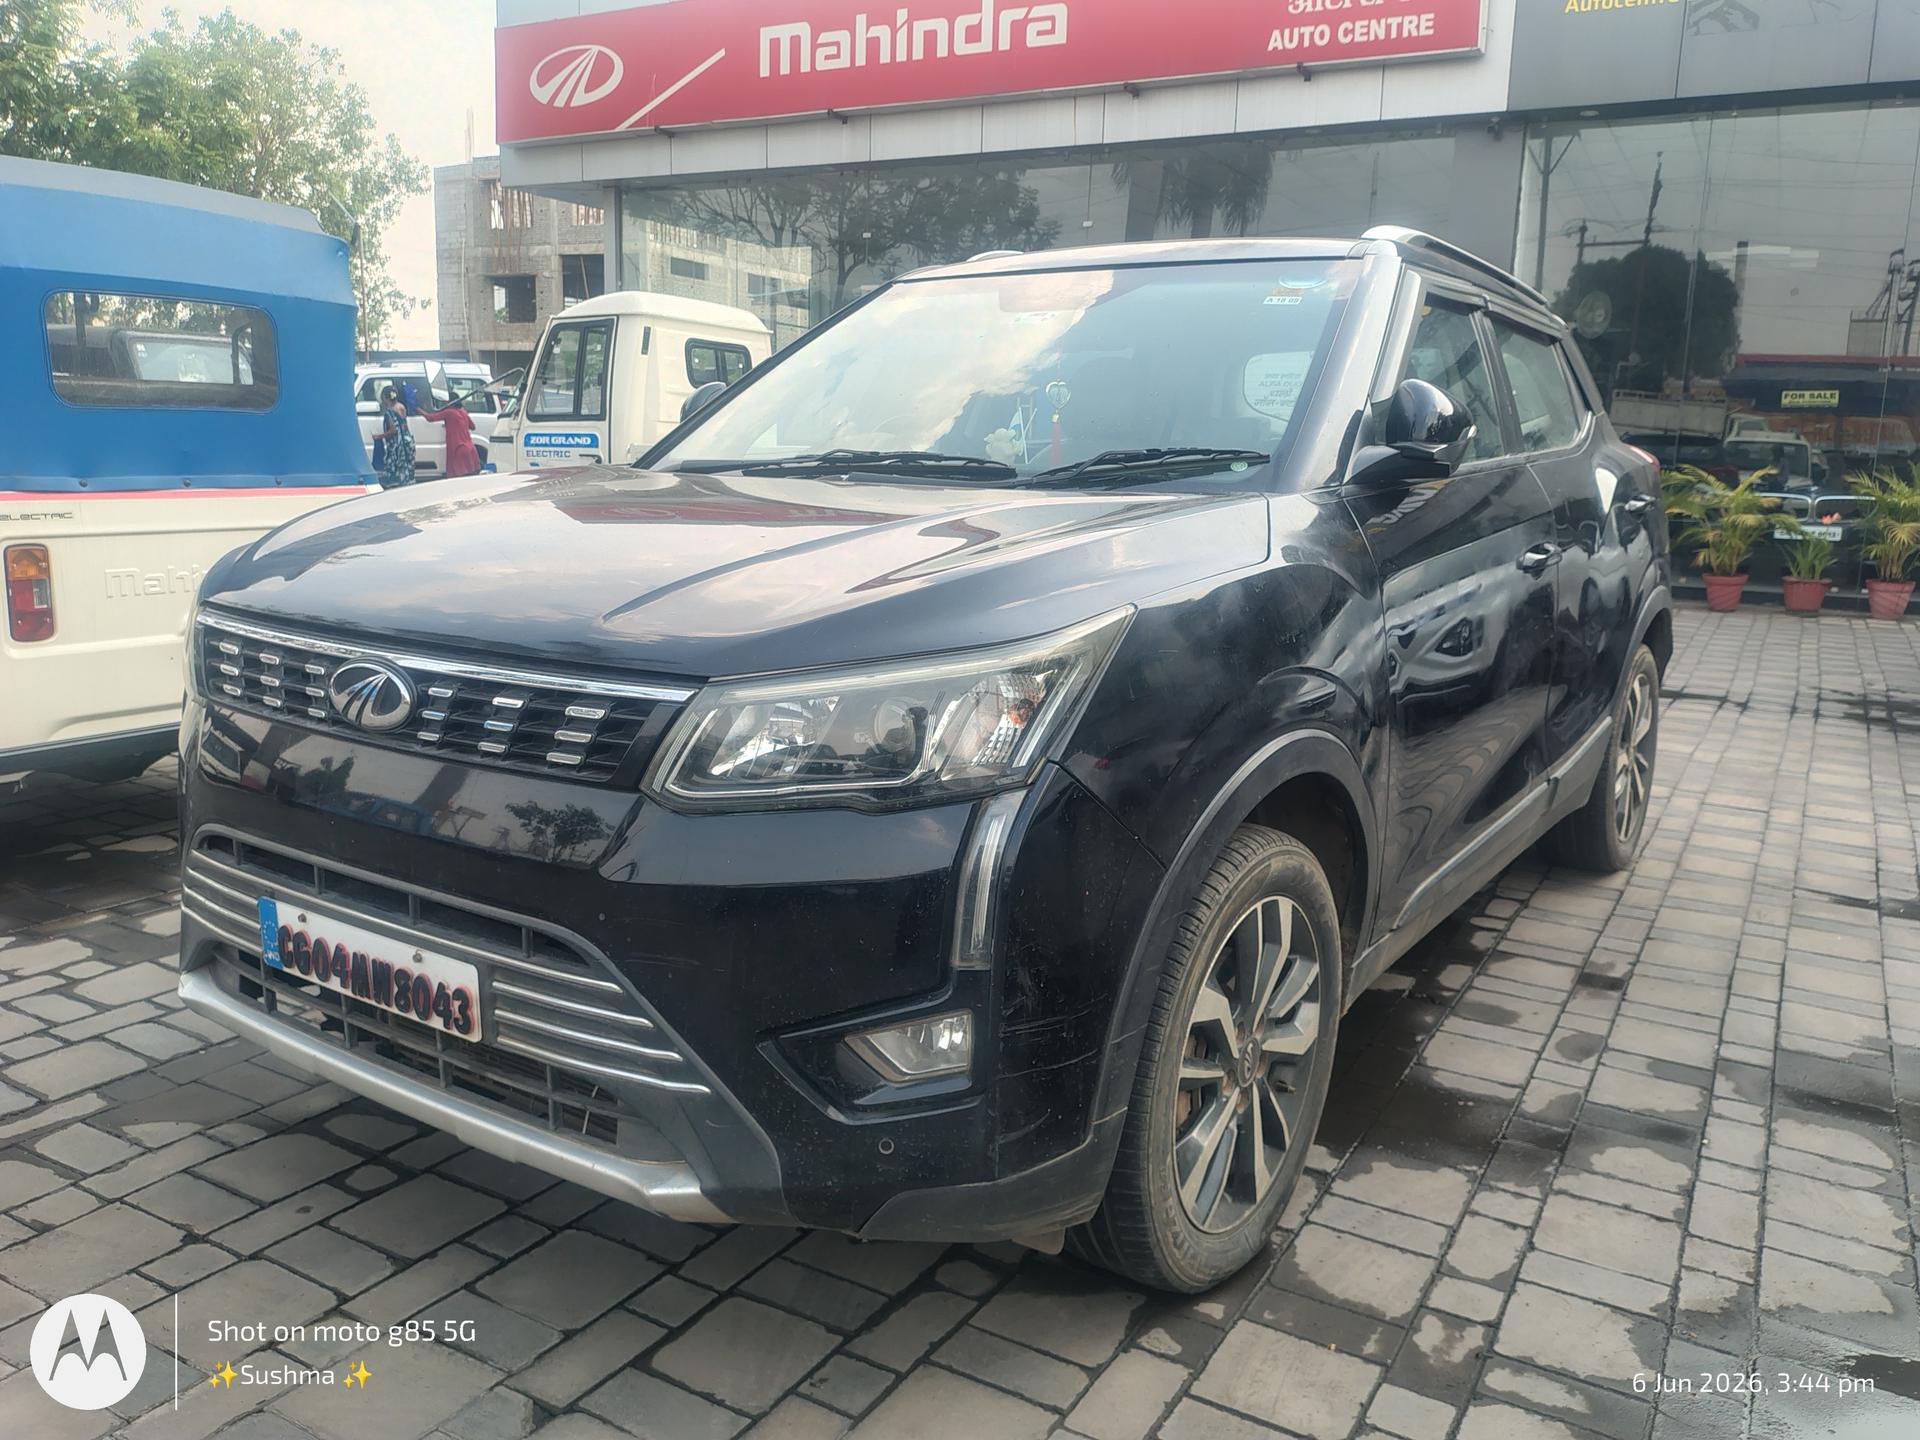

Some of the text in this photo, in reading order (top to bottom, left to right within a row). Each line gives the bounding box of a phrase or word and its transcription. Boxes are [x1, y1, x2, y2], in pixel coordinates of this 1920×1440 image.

[759, 0, 1068, 78] Mahindra
[1267, 13, 1435, 51] AUTO CENTRE
[1784, 392, 1837, 400] FOR SALE
[526, 450, 571, 458] ELECTRIC
[530, 436, 592, 445] ZOR GRAND
[104, 563, 206, 599] Mahi
[278, 924, 475, 1035] CG04MW8043
